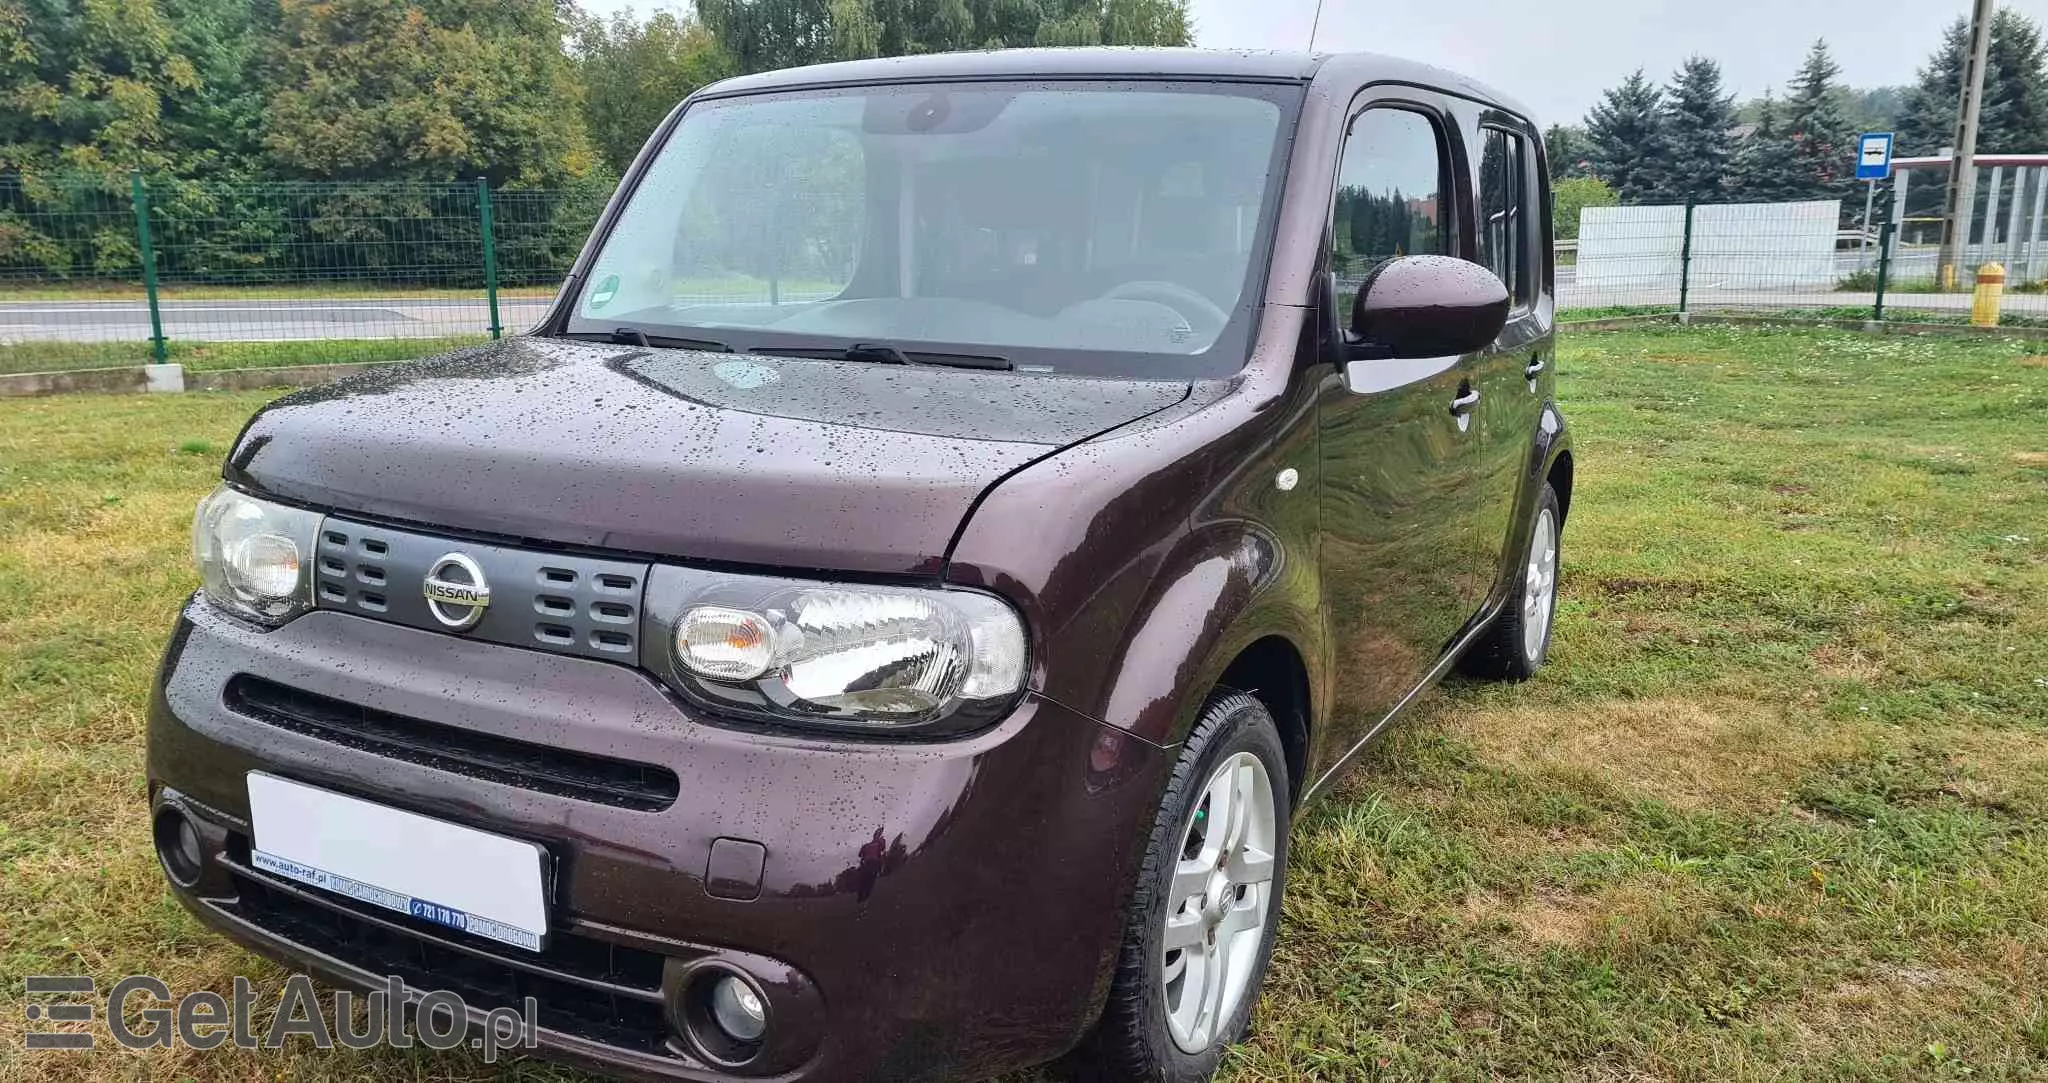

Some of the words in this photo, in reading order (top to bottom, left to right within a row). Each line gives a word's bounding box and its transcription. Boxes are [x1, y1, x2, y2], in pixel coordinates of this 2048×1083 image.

[425, 583, 478, 602] NISSAN
[255, 854, 327, 884] www.auto-raf.pl
[422, 903, 435, 919] 721
